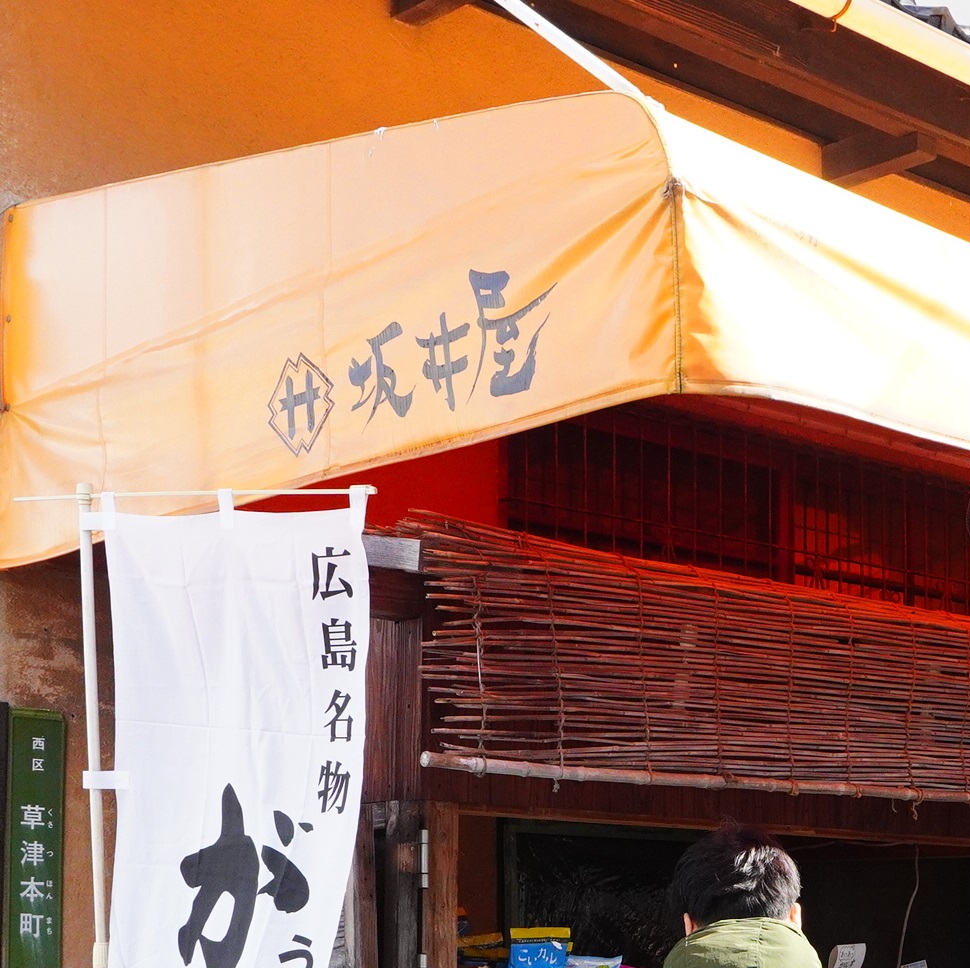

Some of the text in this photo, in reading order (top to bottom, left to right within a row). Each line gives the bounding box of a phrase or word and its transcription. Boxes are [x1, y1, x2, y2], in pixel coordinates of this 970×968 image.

[348, 268, 559, 434] 坂井屋
[31, 737, 45, 771] 西区
[311, 546, 358, 815] 広島名物
[20, 804, 46, 938] 草津本町
